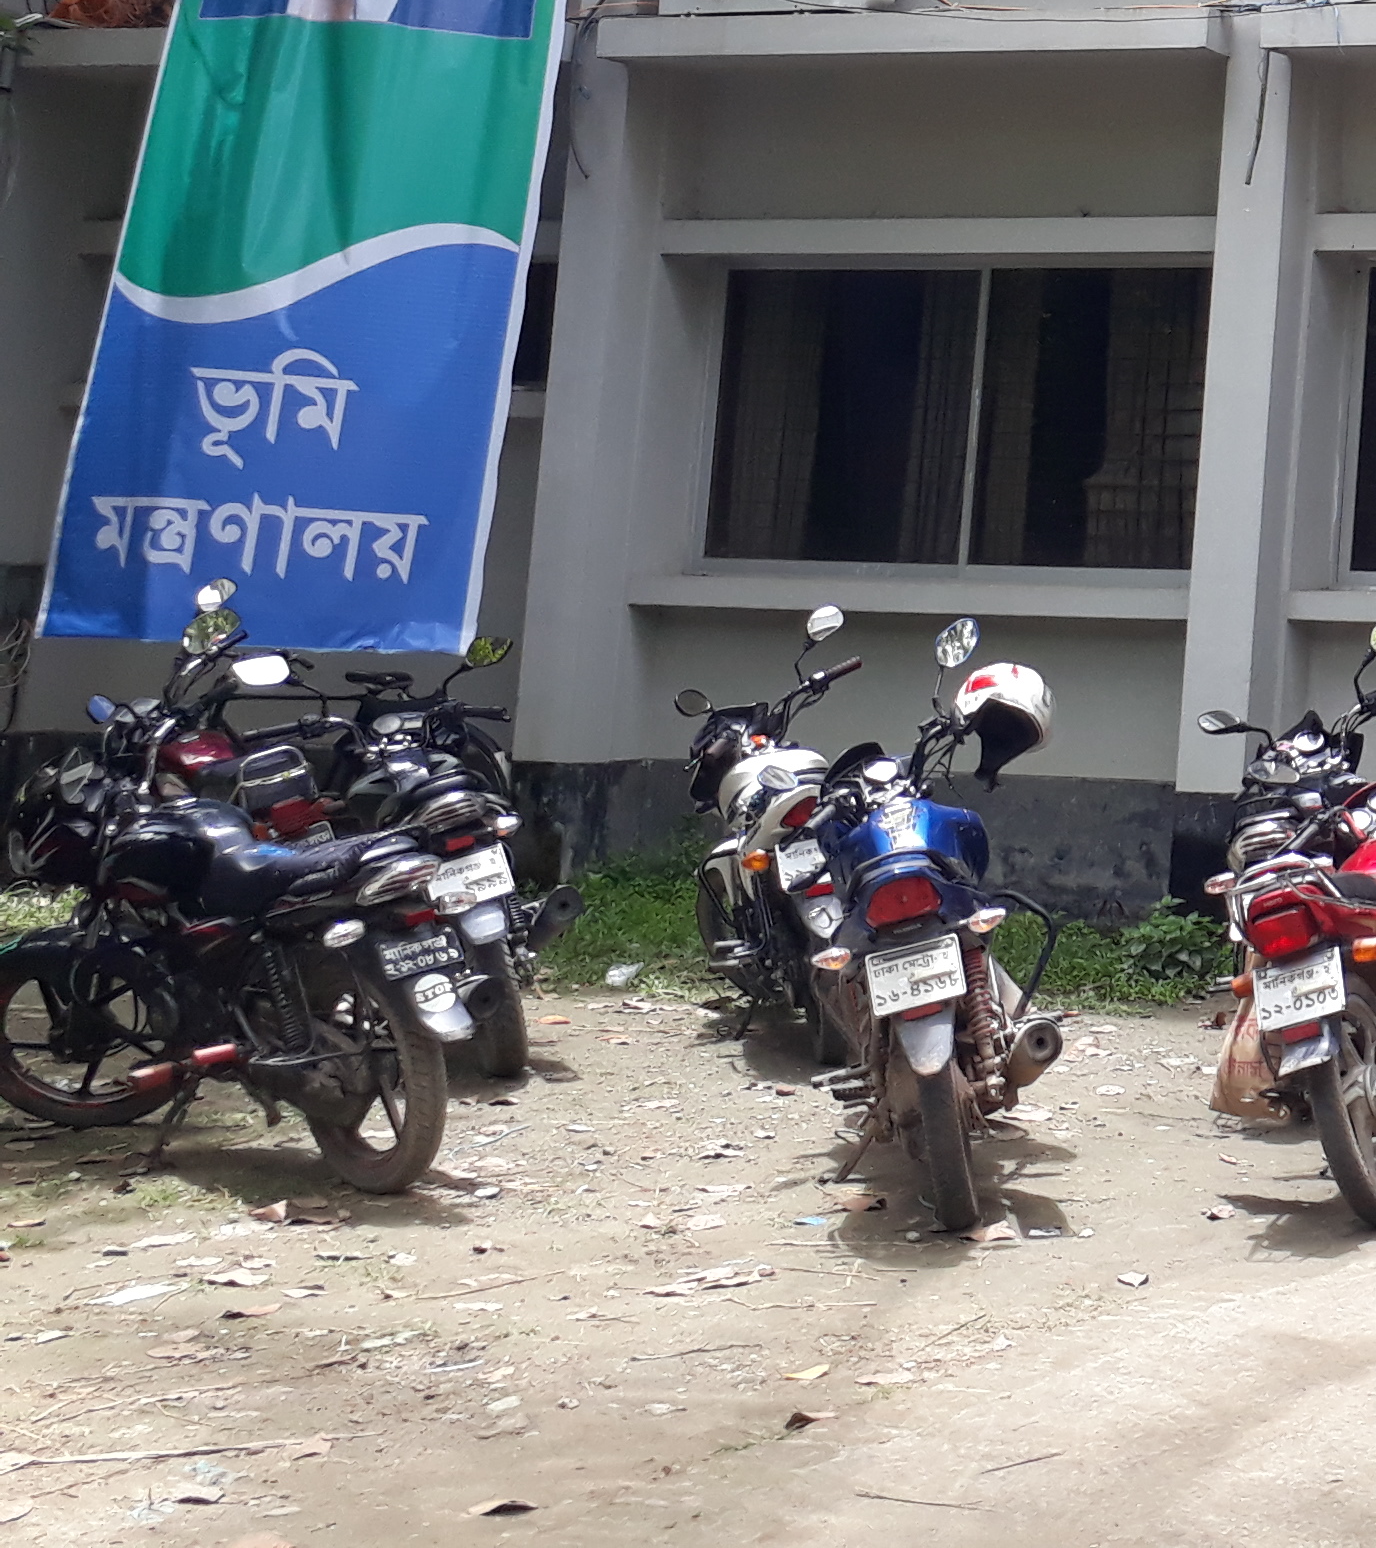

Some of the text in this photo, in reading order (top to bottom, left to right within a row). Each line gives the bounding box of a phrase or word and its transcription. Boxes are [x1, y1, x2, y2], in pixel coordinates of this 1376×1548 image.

[190, 348, 360, 470] ভূমি
[92, 492, 430, 584] মন্ত্রণালয়
[415, 982, 454, 1003] STOP
